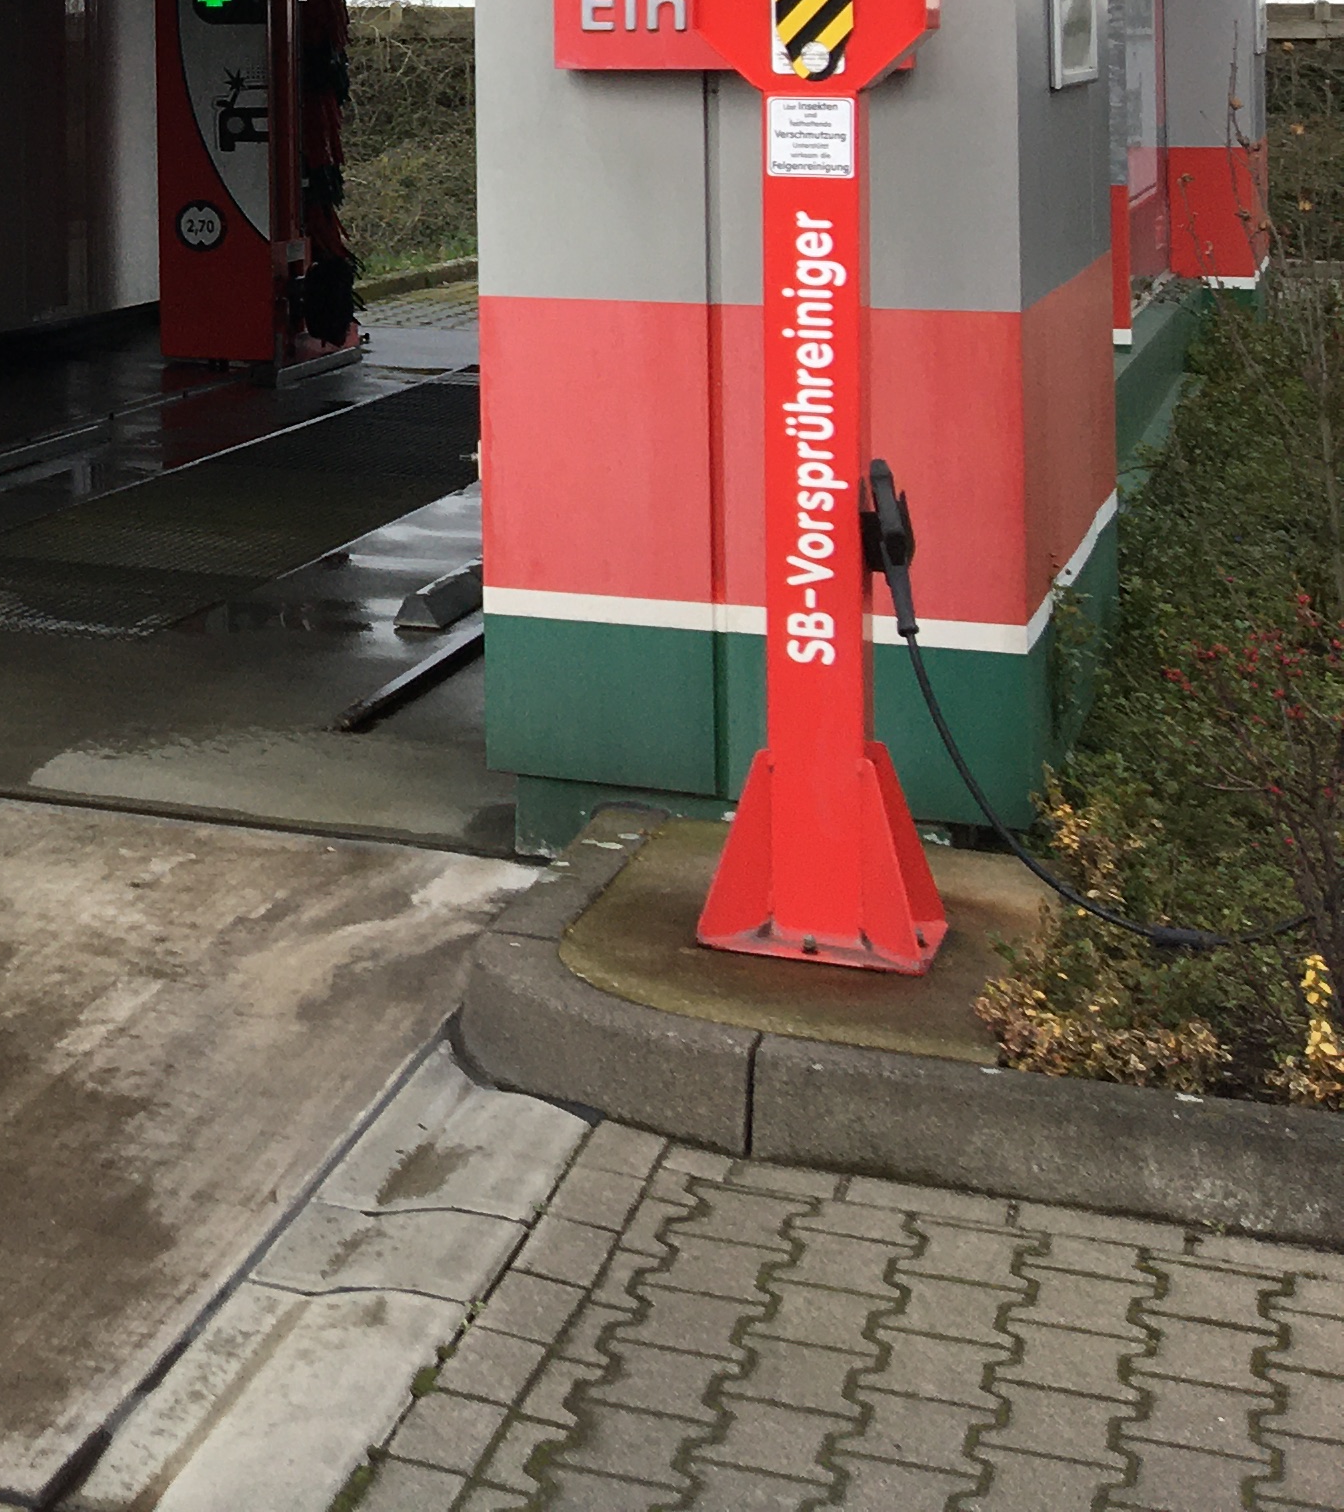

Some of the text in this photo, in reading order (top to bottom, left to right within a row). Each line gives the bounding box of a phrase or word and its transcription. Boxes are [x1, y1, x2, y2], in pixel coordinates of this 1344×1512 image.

[798, 102, 838, 110] Insekten
[774, 130, 847, 142] Verschmutzung
[772, 160, 850, 174] Felgenreinigung
[186, 218, 215, 236] 2,70
[781, 209, 849, 667] SB-Vorsprühreiniger
